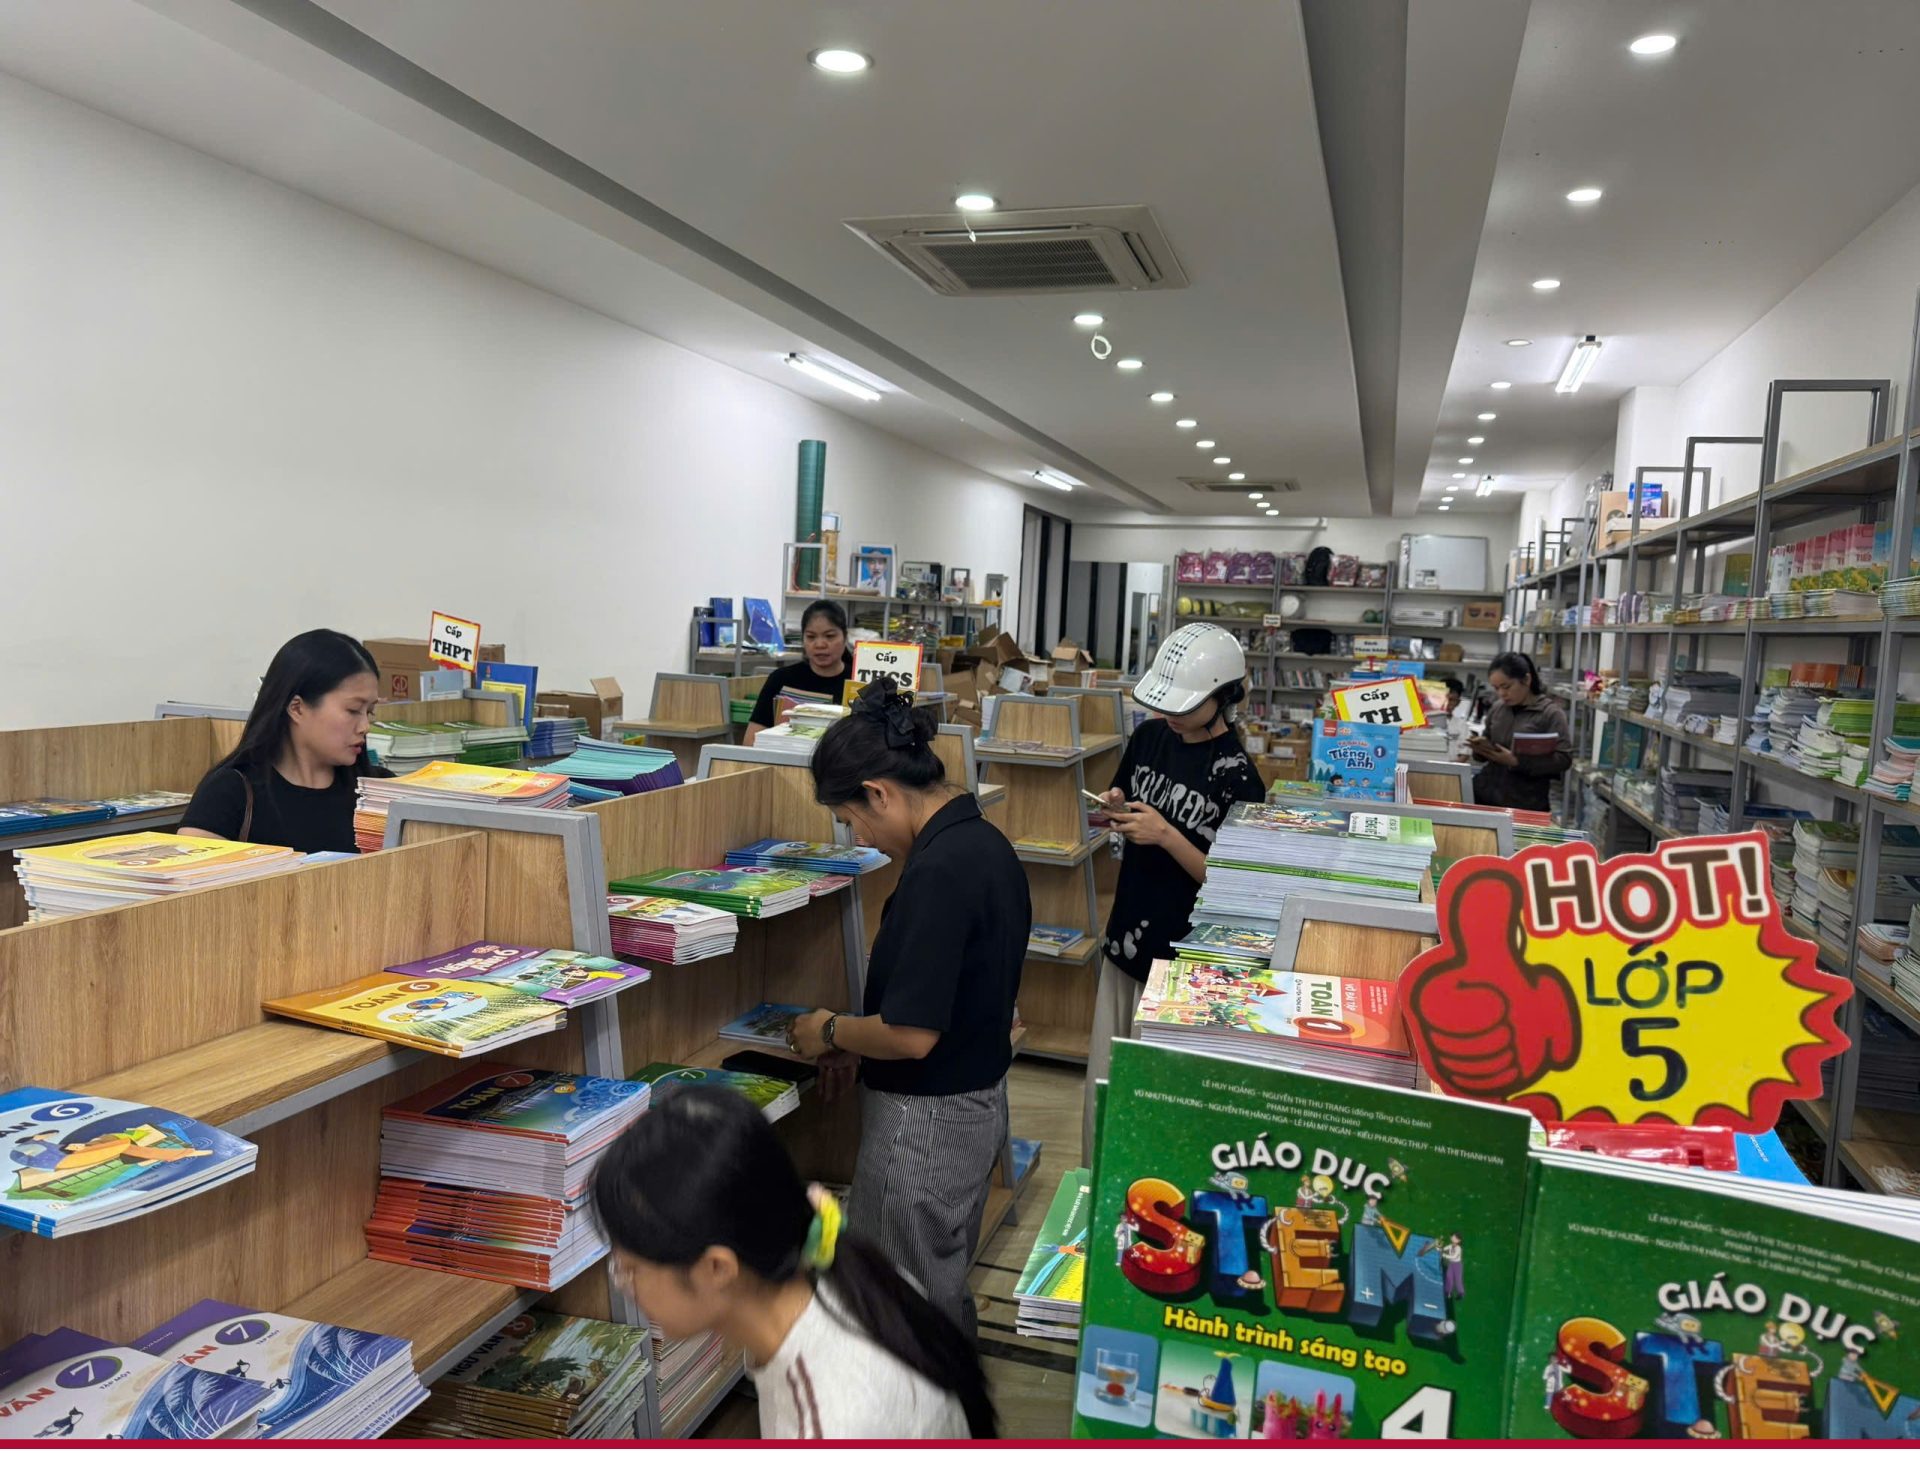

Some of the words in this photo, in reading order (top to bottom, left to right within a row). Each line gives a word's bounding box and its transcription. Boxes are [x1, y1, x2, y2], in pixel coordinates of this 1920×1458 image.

[445, 625, 463, 639] Cấp
[433, 638, 472, 662] THPT
[875, 651, 898, 664] Cấp
[1360, 688, 1390, 702] Cấp
[1359, 706, 1403, 725] TH
[1328, 746, 1366, 762] Tiếng
[1346, 757, 1374, 769] Anh
[1527, 843, 1770, 937] HOT!
[494, 949, 520, 957] 6
[426, 958, 483, 974] TIẾNG
[1584, 941, 1724, 1009] LỚP
[339, 991, 407, 1012] TOÁN
[410, 981, 431, 992] 6
[1310, 981, 1339, 1017] TOÁN
[1307, 1022, 1342, 1031] 1
[1621, 1017, 1688, 1101] 5
[447, 1086, 505, 1110] TOÁN
[1202, 1079, 1211, 1088] LÊ
[1211, 1081, 1228, 1091] HUY
[1228, 1084, 1256, 1096] HOÀNG
[1262, 1090, 1293, 1102] NGUYỄN
[1295, 1097, 1307, 1106] THỊ
[1308, 1099, 1323, 1108] THU
[1324, 1102, 1350, 1114] TRANG
[1375, 1111, 1394, 1123] Tổng
[1395, 1115, 1410, 1125] Chủ
[1412, 1119, 1432, 1130] biên)
[49, 1104, 81, 1118] 6
[1209, 1101, 1239, 1114] NGUYỄN
[1272, 1113, 1288, 1123] NGA
[1266, 1103, 1288, 1114] PHẠM
[1290, 1105, 1303, 1115] THỊ
[1341, 1116, 1360, 1127] biên)
[1211, 1132, 1302, 1171] GIÁO
[1311, 1147, 1391, 1200] DỤC
[1660, 1215, 1678, 1226] HUY
[1121, 1177, 1447, 1342] STEM
[1656, 1271, 1767, 1312] GIÁO
[1778, 1292, 1877, 1355] DỤC
[225, 1322, 250, 1340] 7
[1163, 1306, 1229, 1340] Hành
[1235, 1321, 1294, 1354] trình
[1300, 1337, 1357, 1370] sáng
[1363, 1350, 1408, 1377] tạo
[69, 1360, 96, 1383] 7
[99, 1380, 113, 1391] TẬP
[113, 1370, 131, 1382] MỘT
[1550, 1316, 1920, 1439] STEM
[1382, 1385, 1456, 1439] 4
